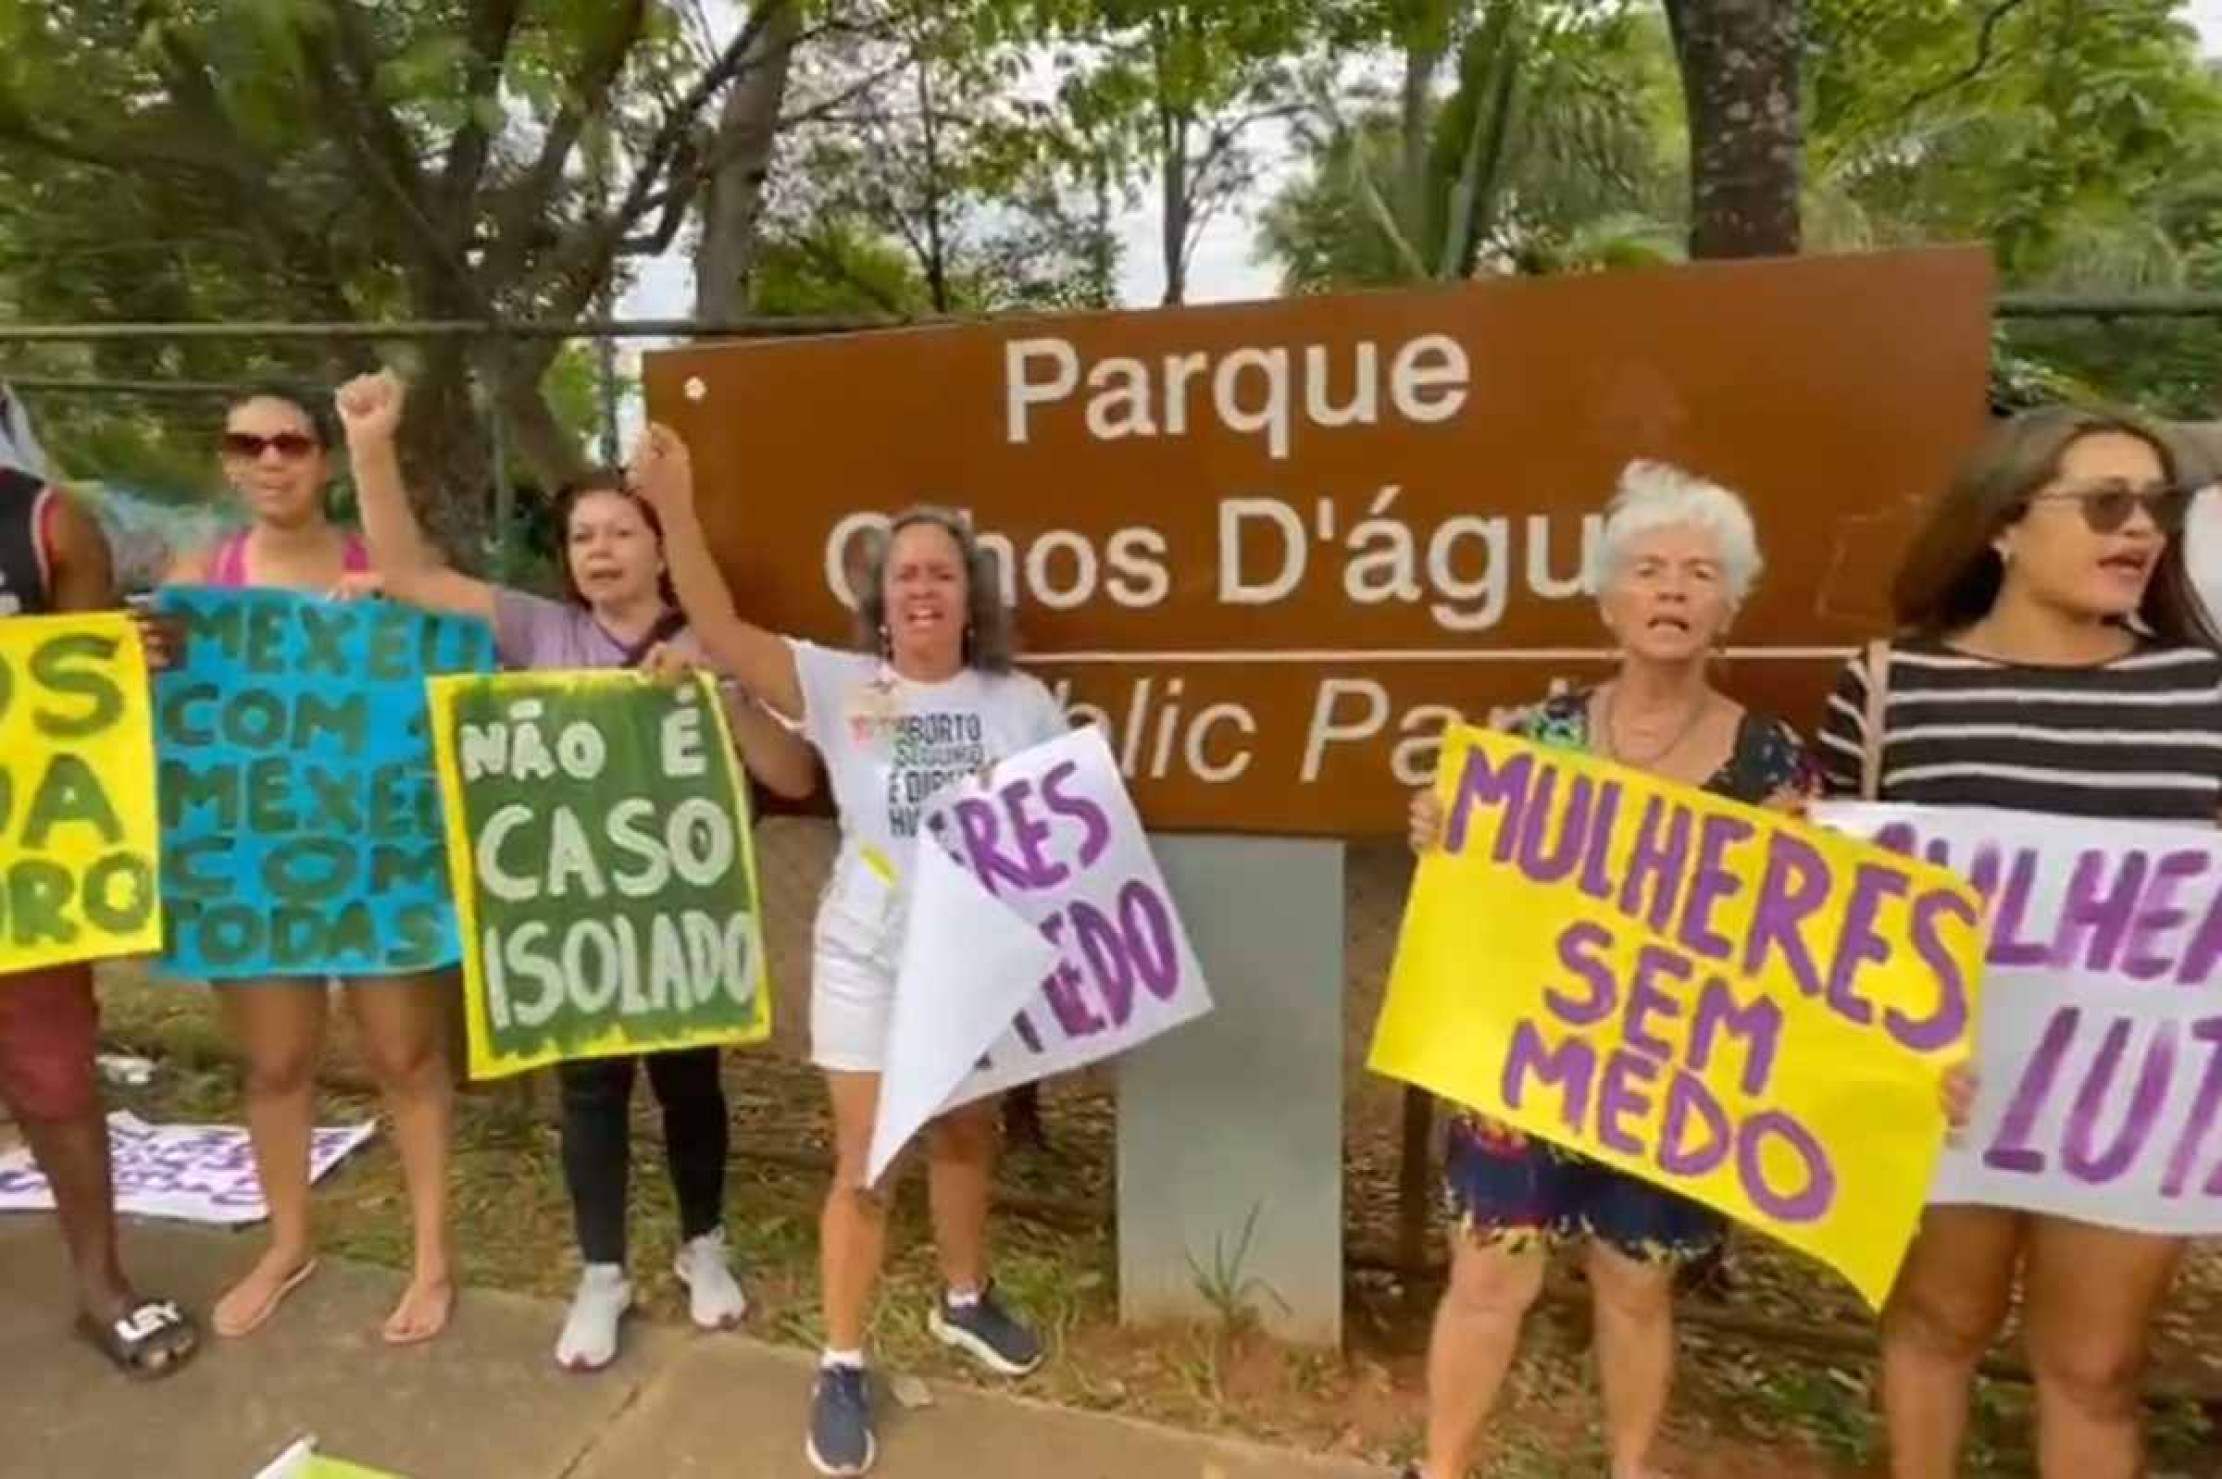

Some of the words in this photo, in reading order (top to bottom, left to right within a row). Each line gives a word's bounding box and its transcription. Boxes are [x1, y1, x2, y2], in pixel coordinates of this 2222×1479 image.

[1003, 332, 1471, 460] Parque
[161, 683, 370, 751] COM
[459, 699, 607, 782] NÃO
[661, 682, 709, 779] É
[477, 797, 735, 901] CASO
[1444, 744, 1979, 1055] MULHERES
[161, 899, 443, 966] TODAS
[484, 908, 762, 1031] ISOLADO
[1543, 920, 1784, 1098] SEM
[1500, 1018, 1836, 1226] MEDO
